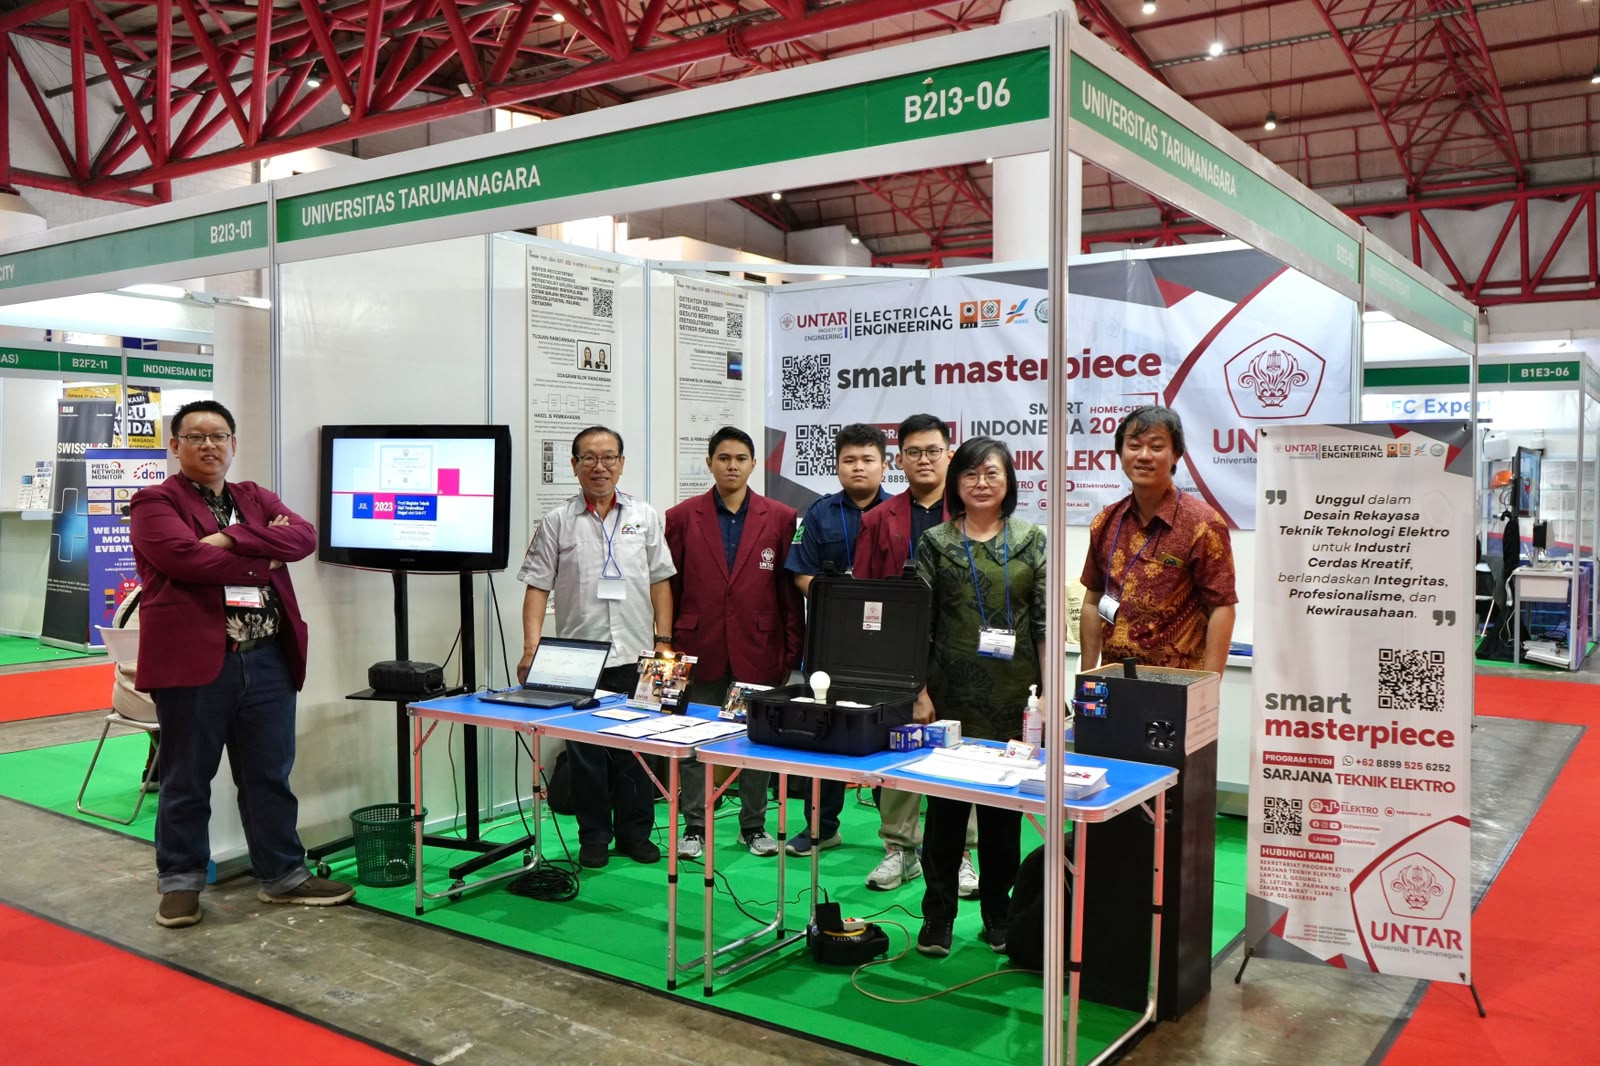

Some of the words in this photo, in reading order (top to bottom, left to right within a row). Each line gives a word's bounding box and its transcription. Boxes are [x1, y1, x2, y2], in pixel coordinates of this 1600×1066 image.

[1082, 80, 1158, 150] UNIVERSITAS
[1161, 130, 1236, 197] TARUMANAGARA
[302, 191, 394, 226] UNIVERSITAS
[398, 165, 541, 210] TARUMANAGARA
[797, 312, 848, 328] UNTAR
[854, 305, 952, 323] ELECTRICAL
[804, 334, 843, 342] ENGINEERING
[854, 318, 953, 337] ENGINEERING
[72, 358, 108, 370] B2F2-11
[143, 364, 197, 377] INDONESIAN
[198, 368, 212, 378] ICT
[837, 360, 926, 390] smart
[1521, 367, 1570, 378] B1E3-06
[1029, 402, 1084, 415] SMRT
[1090, 405, 1143, 414] HOME+CIT
[970, 419, 1084, 436] INDONEIA
[1285, 444, 1318, 452] UNTAR
[1322, 444, 1382, 452] ELECTRICAL
[142, 469, 165, 480] dcm
[1316, 494, 1364, 506] Unggul
[1368, 495, 1411, 504] dalam
[358, 502, 368, 510] JUL
[374, 502, 393, 512] 2023
[1304, 510, 1350, 520] Desain
[1354, 511, 1420, 522] Rekayasa
[93, 526, 110, 534] WE
[112, 526, 130, 534] HEL
[1280, 526, 1323, 536] Teknik
[1327, 526, 1394, 539] Teknologi
[1398, 526, 1450, 538] Elektro
[1312, 542, 1350, 552] untuk
[1354, 542, 1411, 553] Industri
[1308, 558, 1358, 568] Cerdas
[1360, 558, 1413, 570] Kreatif,
[1278, 572, 1370, 584] berlandaskan
[1374, 575, 1449, 588] Integritas,
[1289, 588, 1406, 603] Profesionalisme,
[1409, 592, 1436, 602] dan
[1306, 605, 1418, 618] Kewirausahaan.
[1265, 692, 1352, 714] smart
[1265, 718, 1455, 750] masterpiece
[1265, 754, 1306, 764] PROGRAM
[1308, 757, 1332, 766] STUDI
[1356, 758, 1374, 766] +62
[1376, 760, 1402, 769] 8899
[1404, 761, 1423, 770] 525
[1426, 762, 1451, 772] 6252
[1263, 768, 1333, 784] SARJANA
[1335, 773, 1388, 788] TEKNIK
[1390, 778, 1456, 794] ELEKTRO
[1341, 804, 1378, 814] ELEKTRO
[1342, 838, 1376, 846] ElektroUntar
[1262, 848, 1306, 858] HUBUNGI
[1308, 852, 1333, 861] KAMI
[1260, 860, 1300, 868] SEKRETARIAT
[1302, 864, 1334, 872] PROGRAM
[1371, 920, 1464, 951] UNTAR
[1370, 942, 1410, 954] Universitas
[1412, 946, 1464, 960] Tarumanagara
